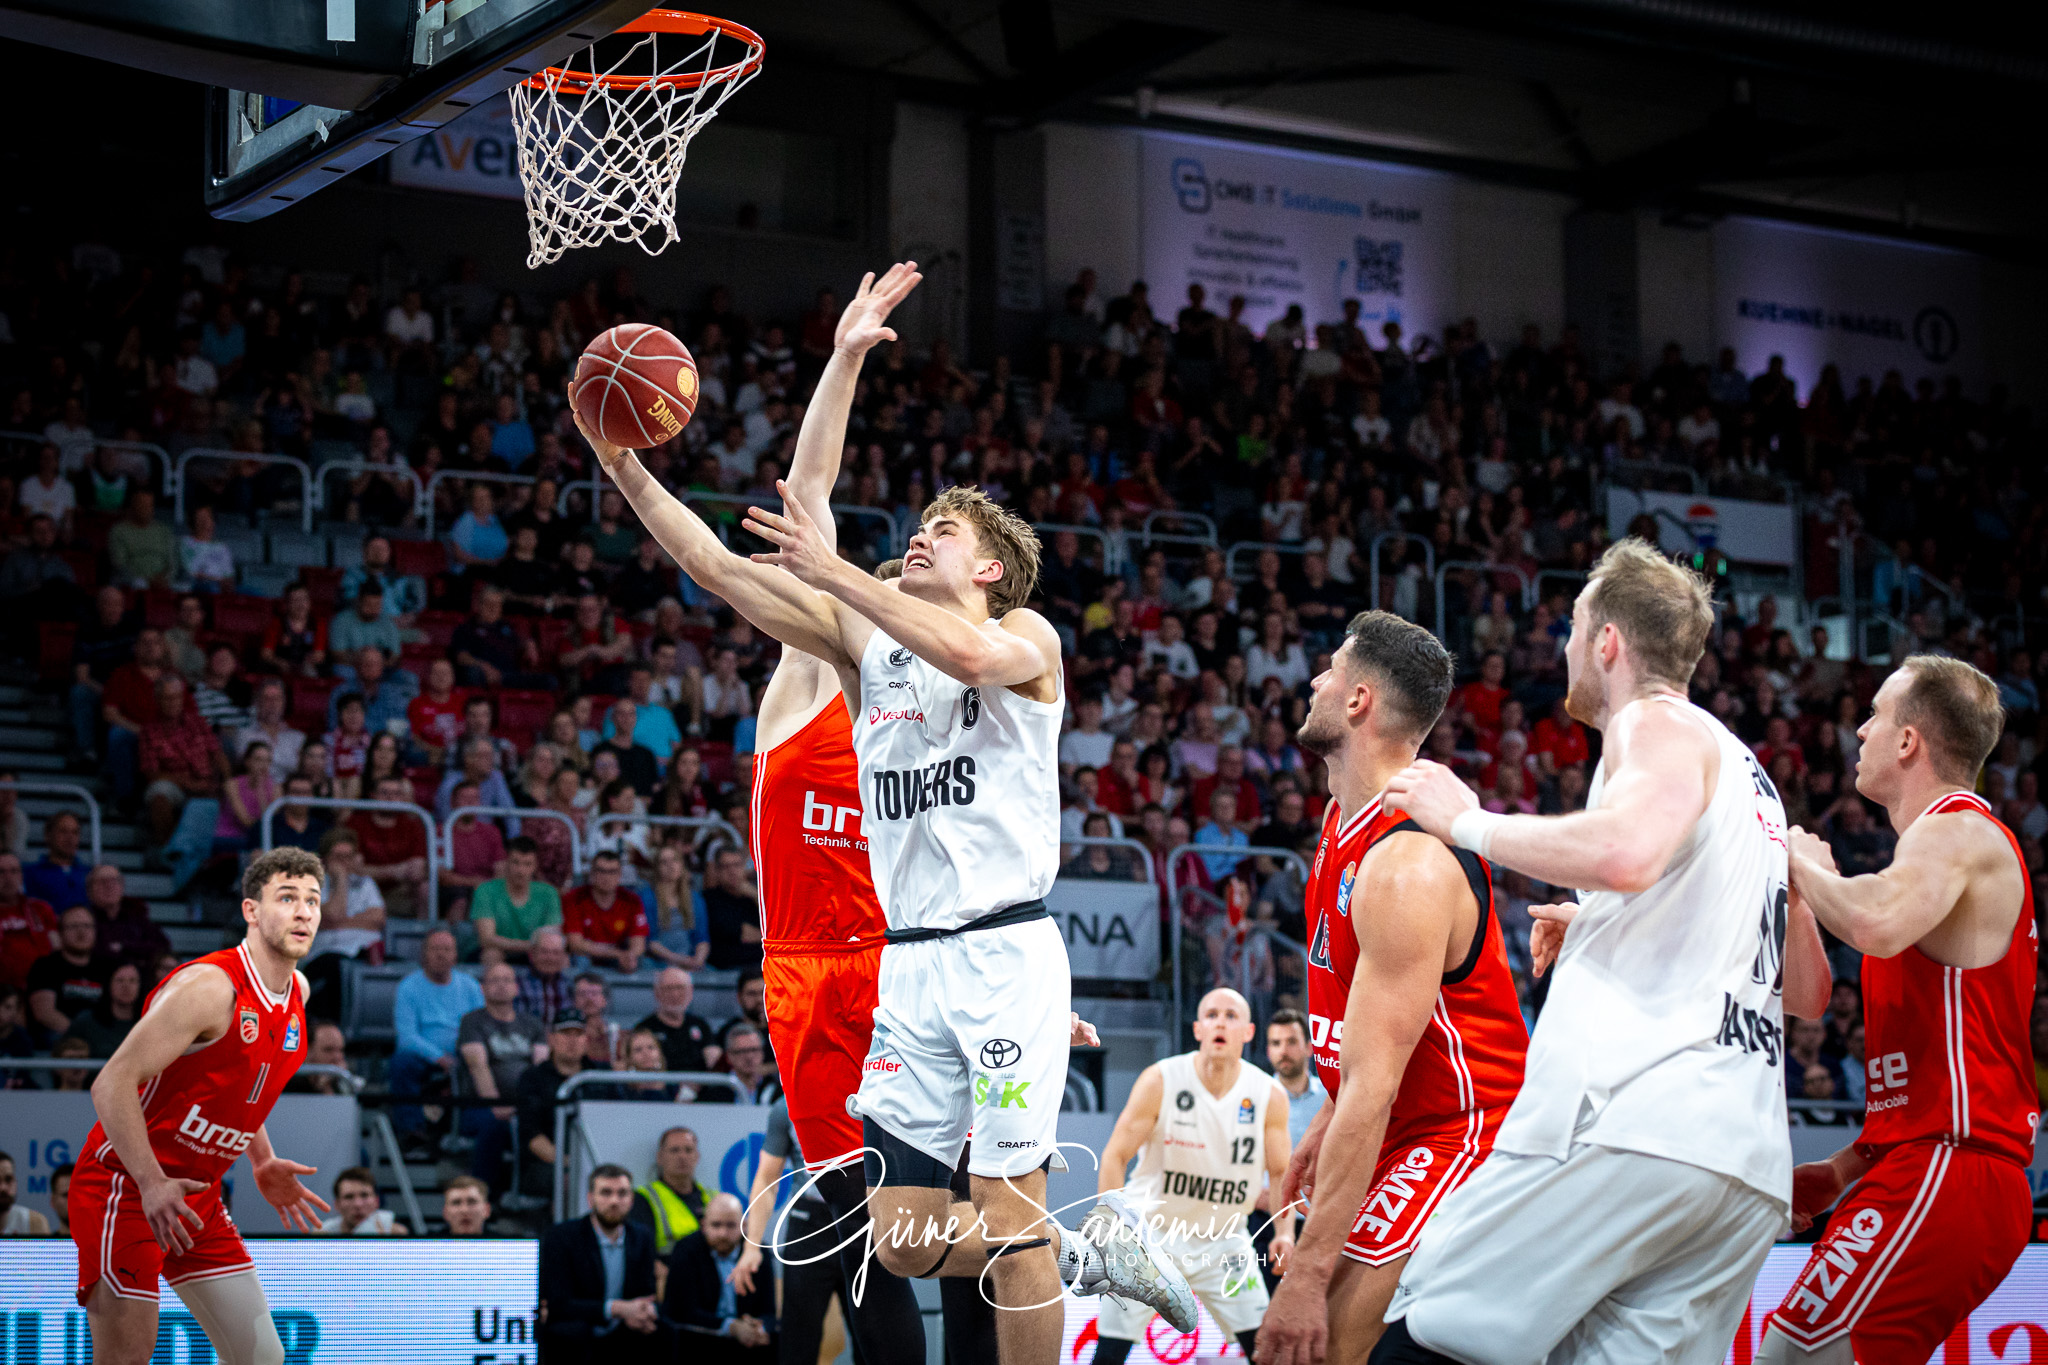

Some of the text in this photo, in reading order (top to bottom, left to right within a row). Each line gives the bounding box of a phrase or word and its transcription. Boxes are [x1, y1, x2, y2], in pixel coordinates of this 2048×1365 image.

[883, 709, 923, 723] VEOLIA
[961, 686, 981, 730] 6
[873, 755, 976, 821] TOWERS
[803, 834, 869, 852] Technik fü
[1047, 911, 1135, 947] NA
[247, 1062, 270, 1104] 11
[1867, 1093, 1909, 1113] Autoobile
[998, 1141, 1031, 1149] CRAFT
[1230, 1137, 1255, 1165] 12
[1164, 1170, 1249, 1205] TOWERS
